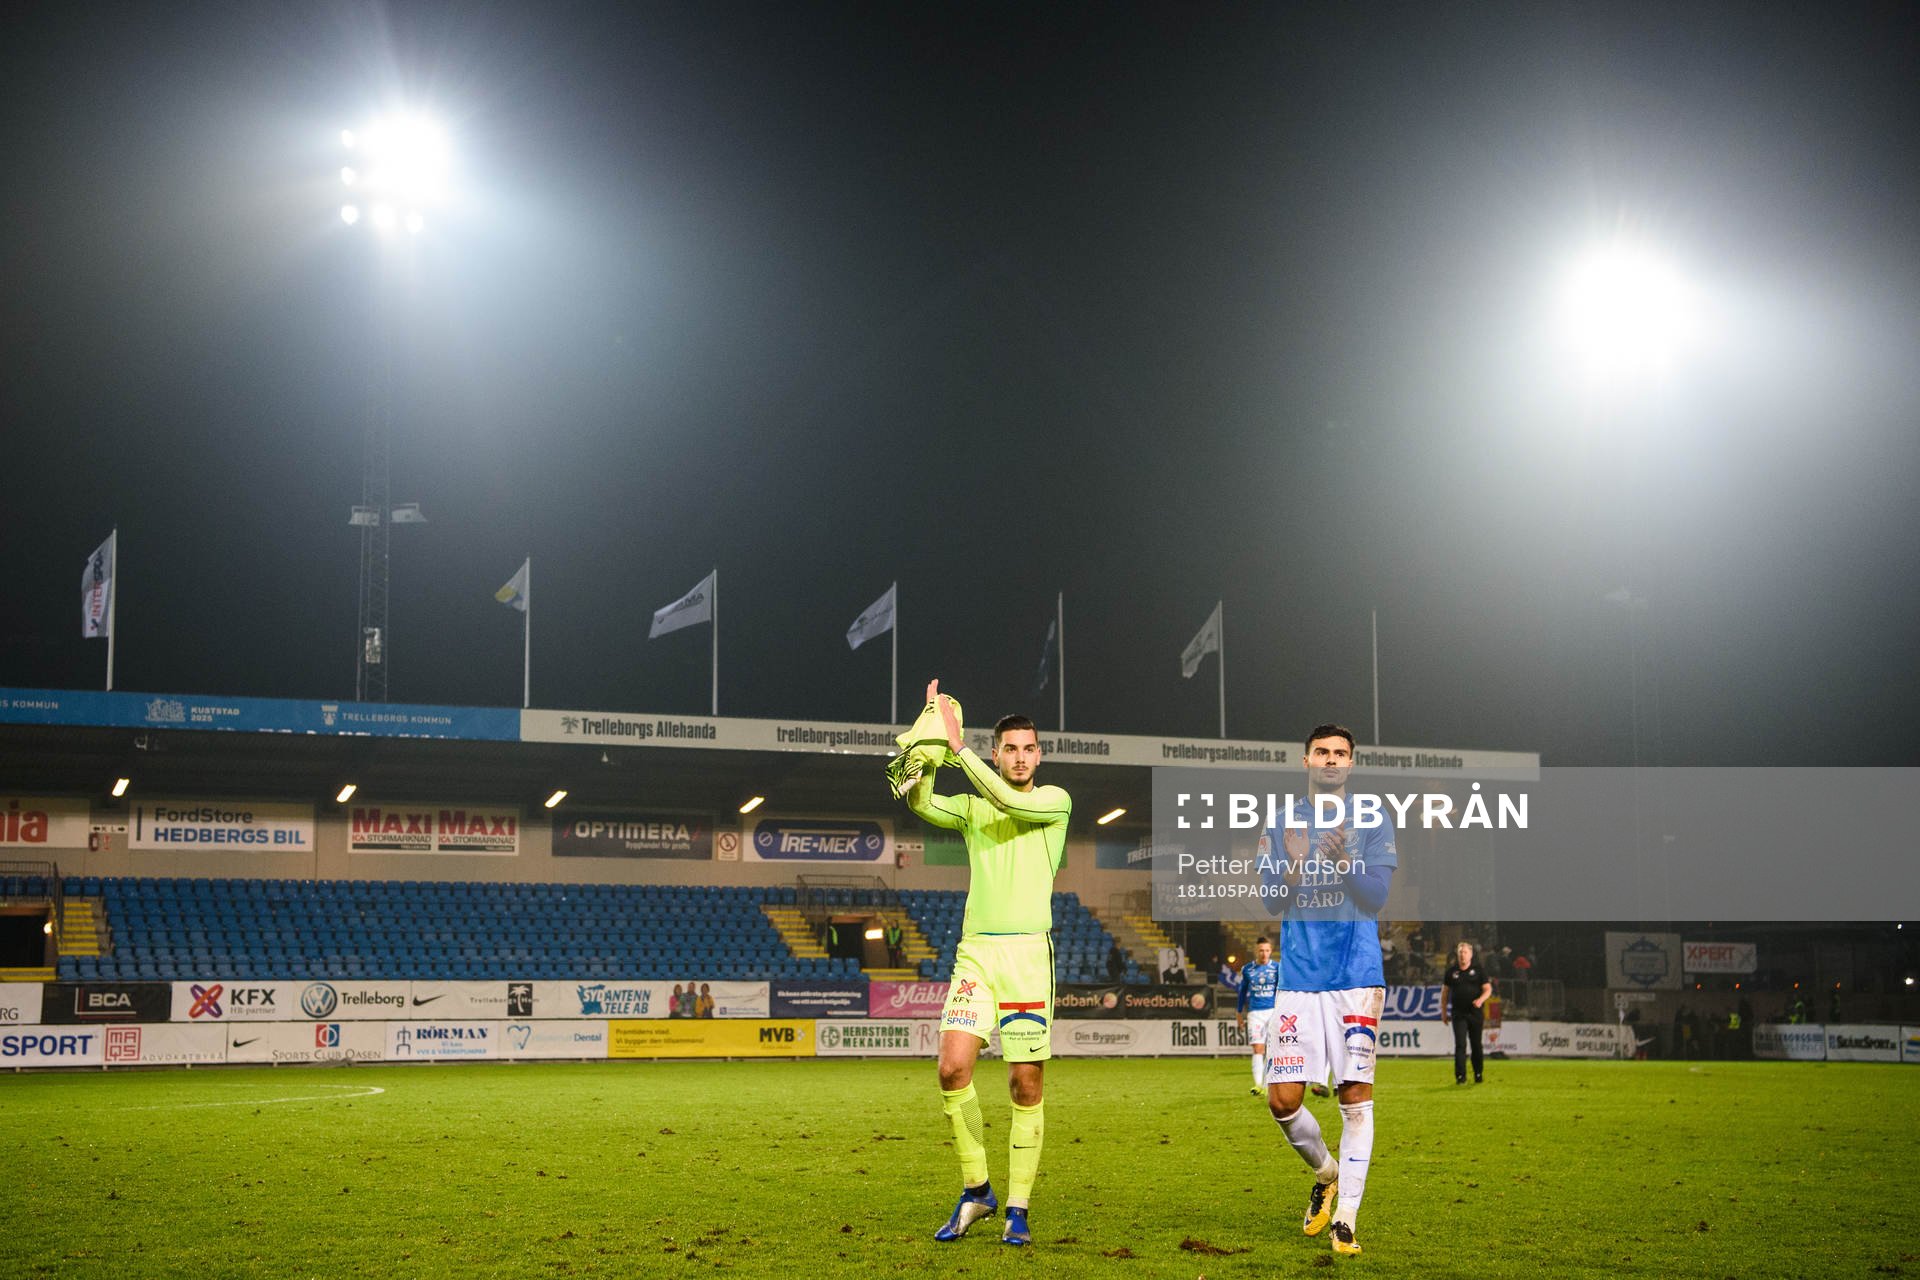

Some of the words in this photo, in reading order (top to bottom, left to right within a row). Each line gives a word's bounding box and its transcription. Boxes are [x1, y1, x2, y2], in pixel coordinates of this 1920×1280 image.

[13, 701, 59, 709] KOMMUN
[191, 706, 240, 715] KUSTSTAD
[342, 713, 408, 723] TRELLEBORGS
[411, 716, 452, 724] KOMMUN
[582, 718, 653, 739] Trelleborgs
[656, 721, 716, 739] Allehanda
[777, 726, 897, 747] trelleborgsallehanda
[1057, 738, 1110, 756] Allehanda
[1162, 743, 1287, 763] trelleborgsallehanda.se
[1355, 750, 1413, 769] Trelleborgs
[1415, 753, 1464, 770] Allehanda
[155, 807, 253, 824] FordStore
[352, 808, 432, 835] MAXI
[438, 810, 516, 836] MAXI
[154, 827, 269, 845] HEDBERGS
[273, 829, 305, 845] BIL
[575, 821, 691, 841] OPTIMERA
[367, 835, 432, 843] STORMARKNAD
[453, 836, 516, 844] STORMARKNAD
[1296, 890, 1345, 908] GÅRD
[1687, 945, 1735, 960] XPERT
[89, 993, 131, 1007] BCA
[230, 989, 276, 1005] KFX
[341, 992, 405, 1007] Trelleborg
[1054, 992, 1101, 1008] edbank
[1125, 993, 1190, 1010] Swedbank
[1383, 986, 1453, 1016] LUE
[605, 1002, 631, 1014] TELE
[633, 1002, 649, 1014] AB
[948, 1010, 978, 1020] INTER
[947, 1018, 976, 1027] SPORT
[416, 1026, 488, 1040] RÖRMAN
[574, 1033, 602, 1041] Dental
[759, 1028, 795, 1042] MVB
[843, 1026, 910, 1037] HERRSTRÖMS
[1075, 1032, 1089, 1041] Din
[1092, 1031, 1130, 1043] Byggare
[1171, 1022, 1206, 1046] flash
[1379, 1028, 1421, 1048] emt
[1576, 1027, 1605, 1038] KIOSK
[2, 1035, 93, 1056] SPORT
[843, 1038, 910, 1048] MEKANISKA
[1576, 1040, 1629, 1052] SPELBUTK
[141, 1052, 224, 1062] ADVOKATBYRÅ
[272, 1050, 312, 1060] SPORTS
[314, 1049, 339, 1060] CLUB
[345, 1049, 381, 1059] OASEN
[1273, 1056, 1304, 1066] INTER
[1273, 1065, 1304, 1074] SPORT
